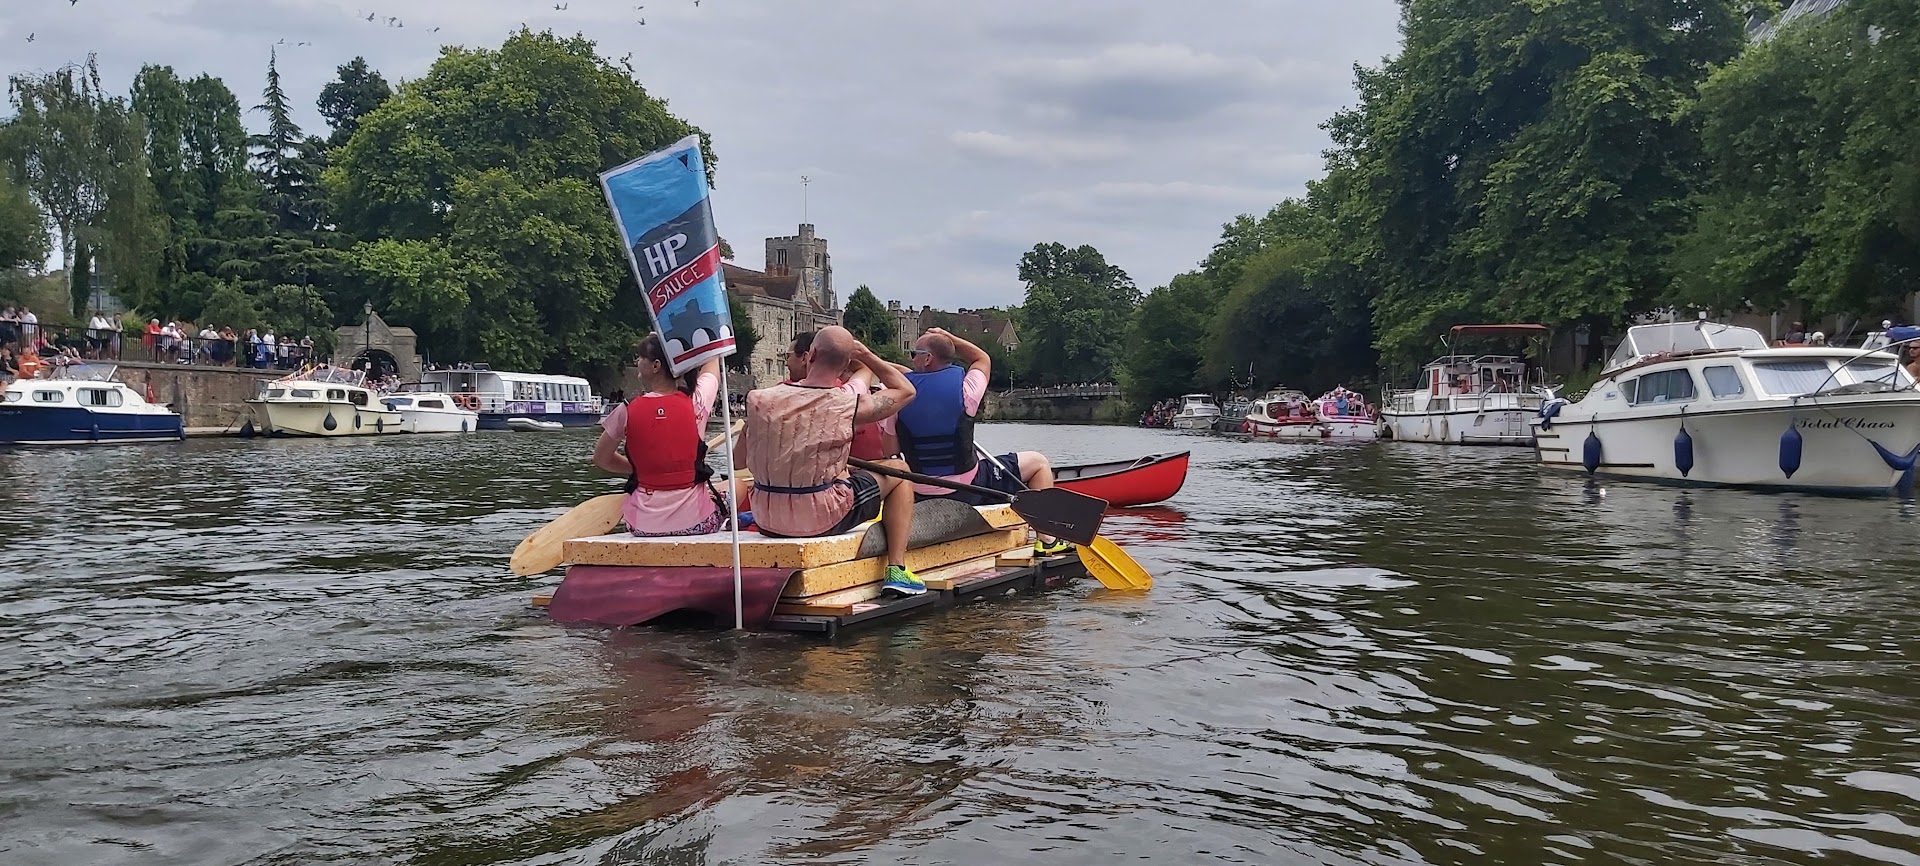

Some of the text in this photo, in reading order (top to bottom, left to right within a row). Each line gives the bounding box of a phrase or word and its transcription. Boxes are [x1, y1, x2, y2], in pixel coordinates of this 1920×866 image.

[643, 233, 688, 279] HP
[655, 263, 705, 308] SAUCE
[1796, 416, 1895, 429] Total Chaos
